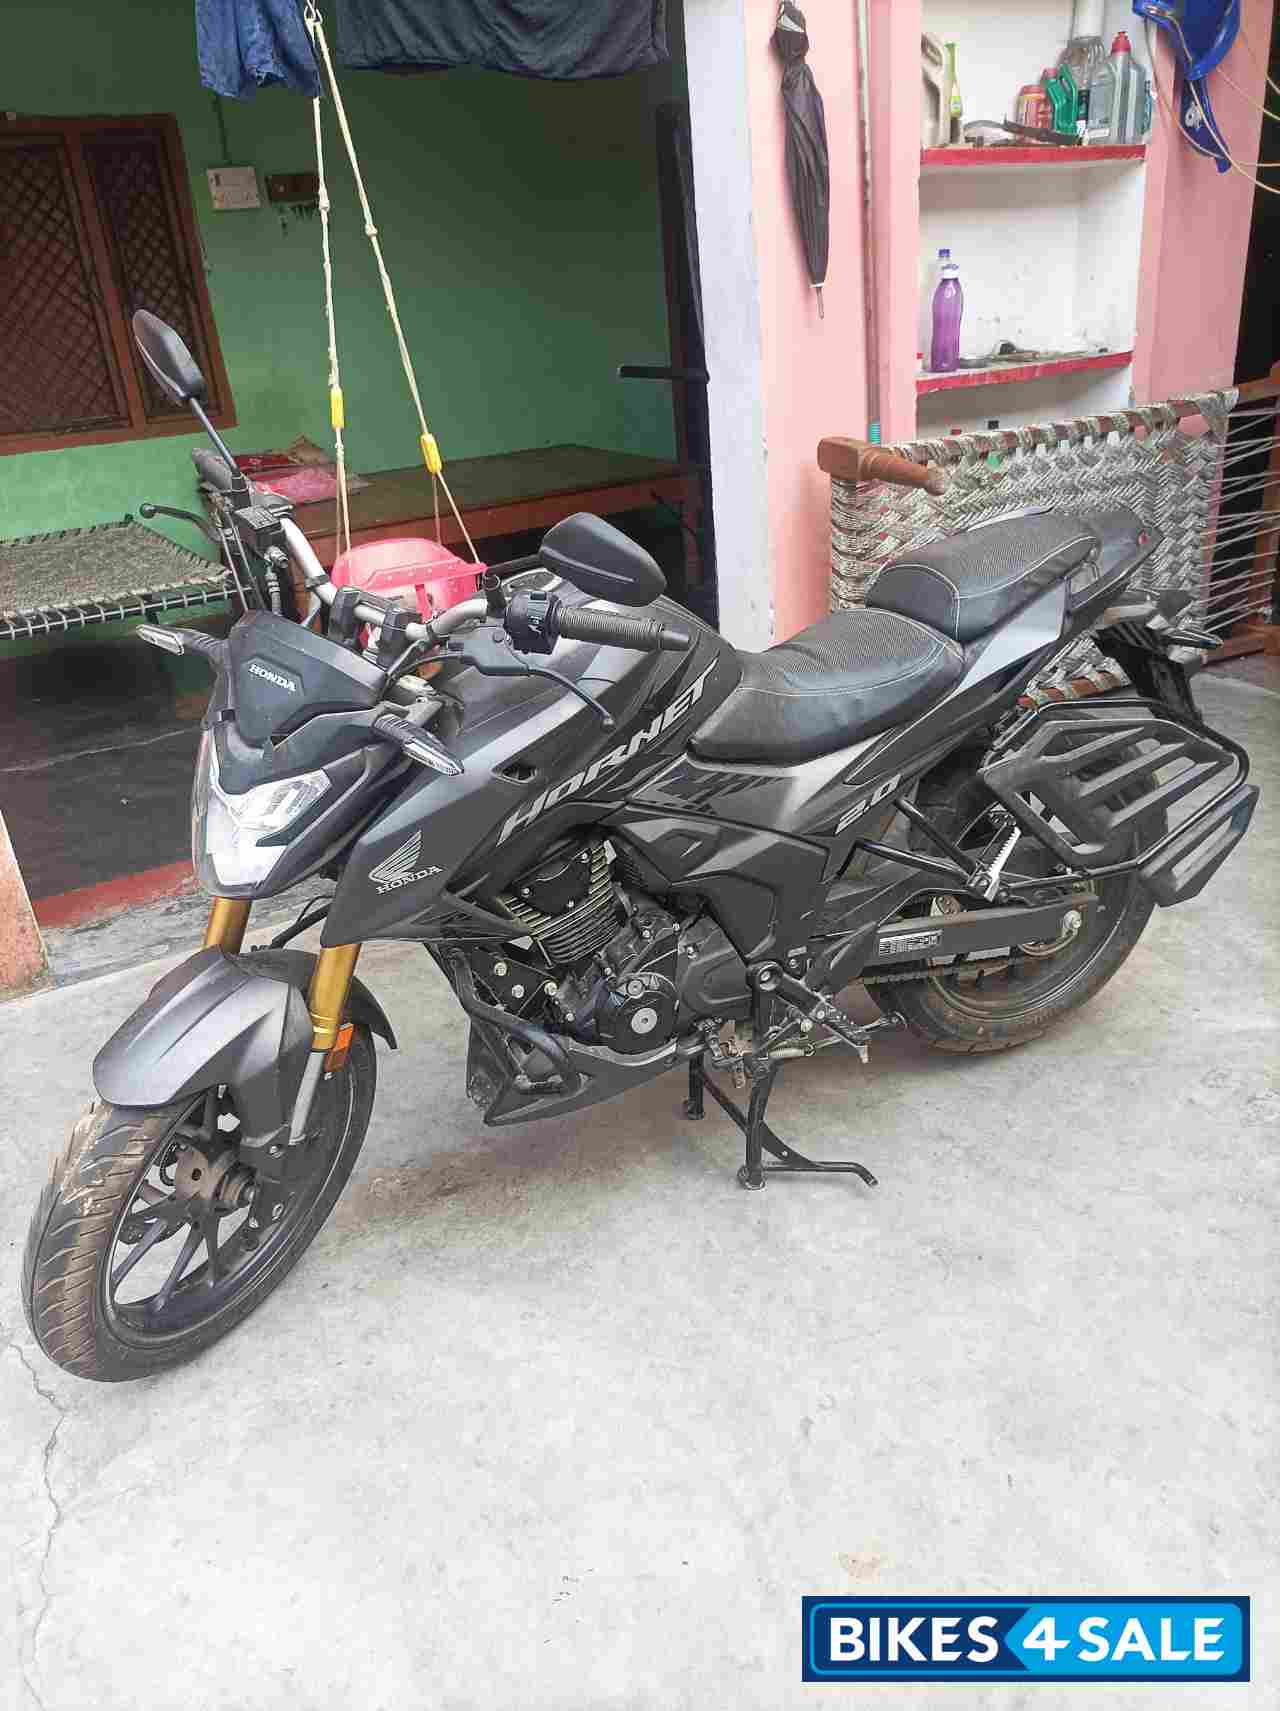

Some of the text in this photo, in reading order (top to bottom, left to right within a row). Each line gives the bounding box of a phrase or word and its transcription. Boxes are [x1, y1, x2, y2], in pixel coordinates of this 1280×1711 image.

[249, 663, 297, 693] HONDA
[496, 653, 721, 847] HORNET
[835, 773, 901, 834] 2.0
[376, 865, 443, 895] HONDA
